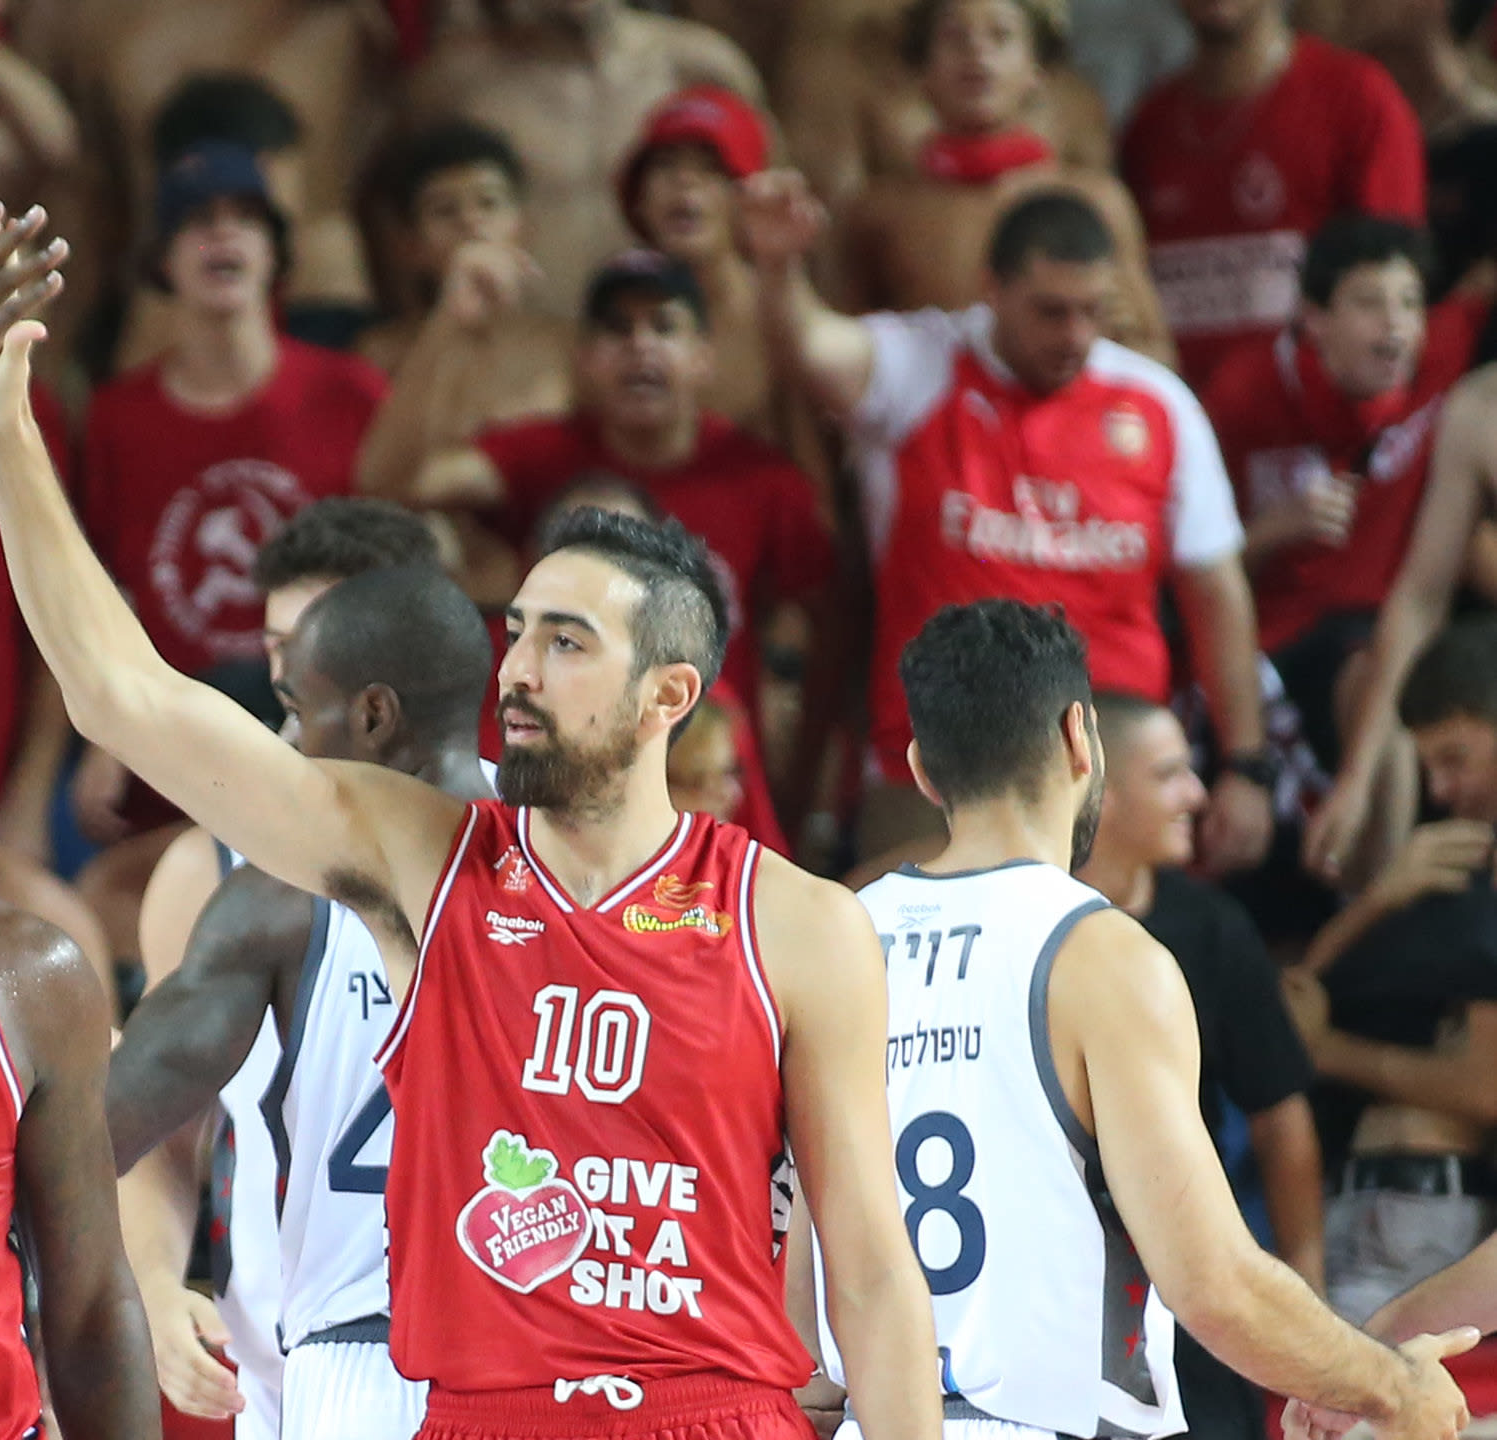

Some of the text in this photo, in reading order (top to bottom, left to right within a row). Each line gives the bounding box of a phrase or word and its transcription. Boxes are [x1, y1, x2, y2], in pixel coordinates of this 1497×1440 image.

[486, 910, 546, 932] Reebok
[521, 984, 652, 1104] 10
[573, 1156, 699, 1213] GIVE
[485, 1211, 581, 1267] FRIENDLY
[490, 1194, 568, 1237] VEGAN
[591, 1208, 689, 1268] IT A
[569, 1259, 702, 1319] SHOT
